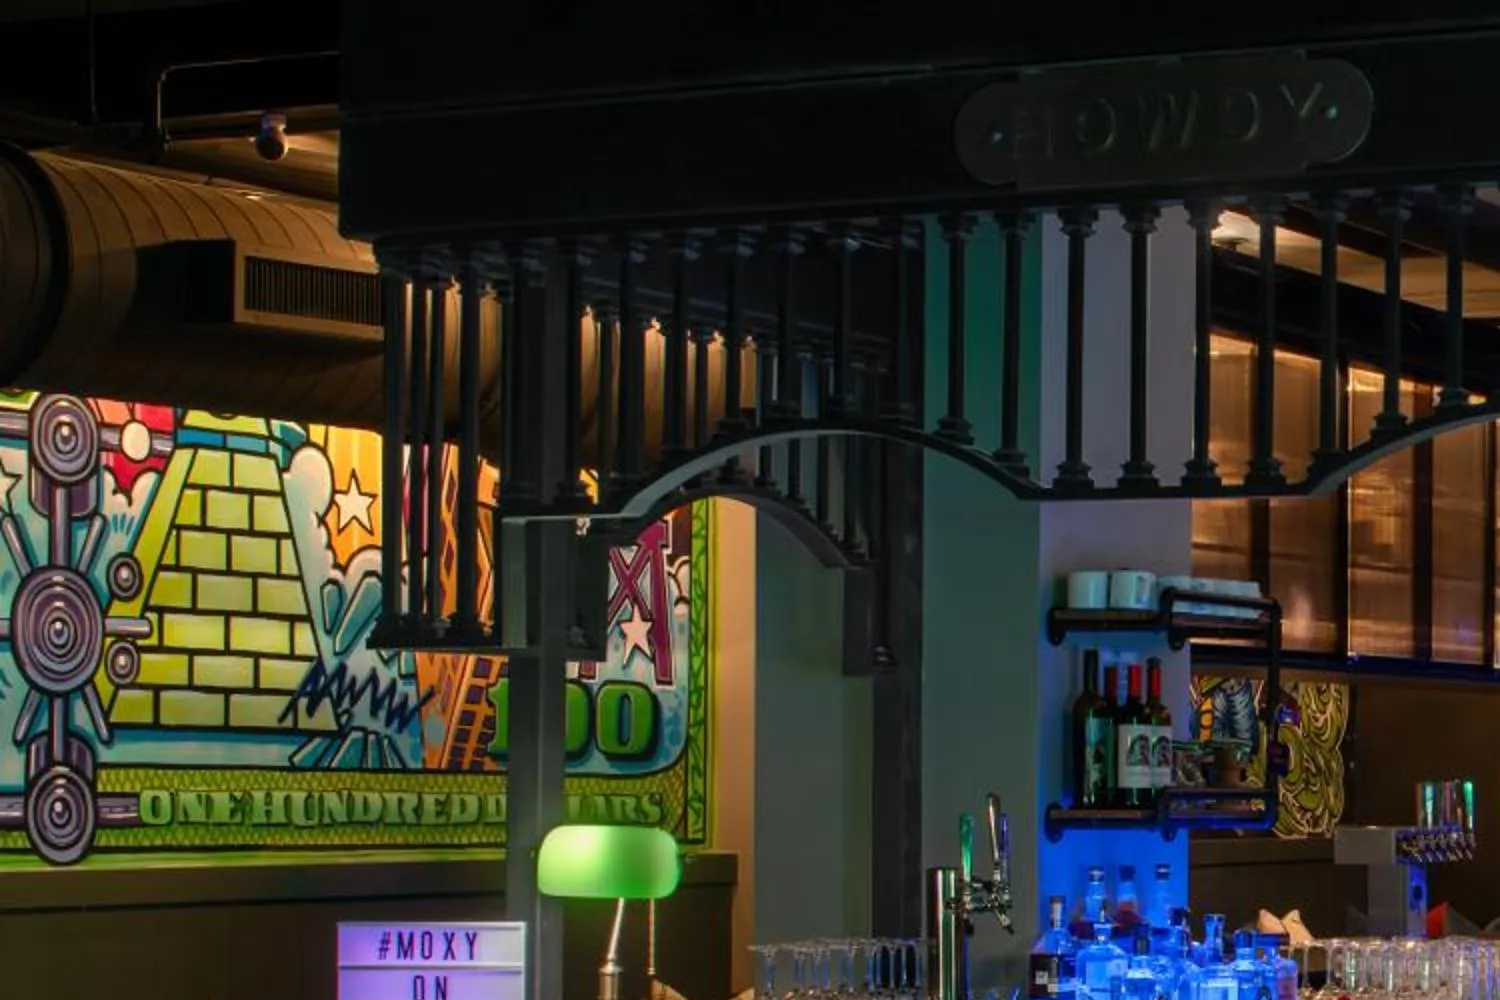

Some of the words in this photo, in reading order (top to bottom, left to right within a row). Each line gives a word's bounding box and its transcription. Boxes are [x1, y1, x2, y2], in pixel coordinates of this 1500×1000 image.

[139, 789, 244, 825] ONE
[250, 790, 482, 826] HUNDRED
[378, 931, 478, 961] #MOXY
